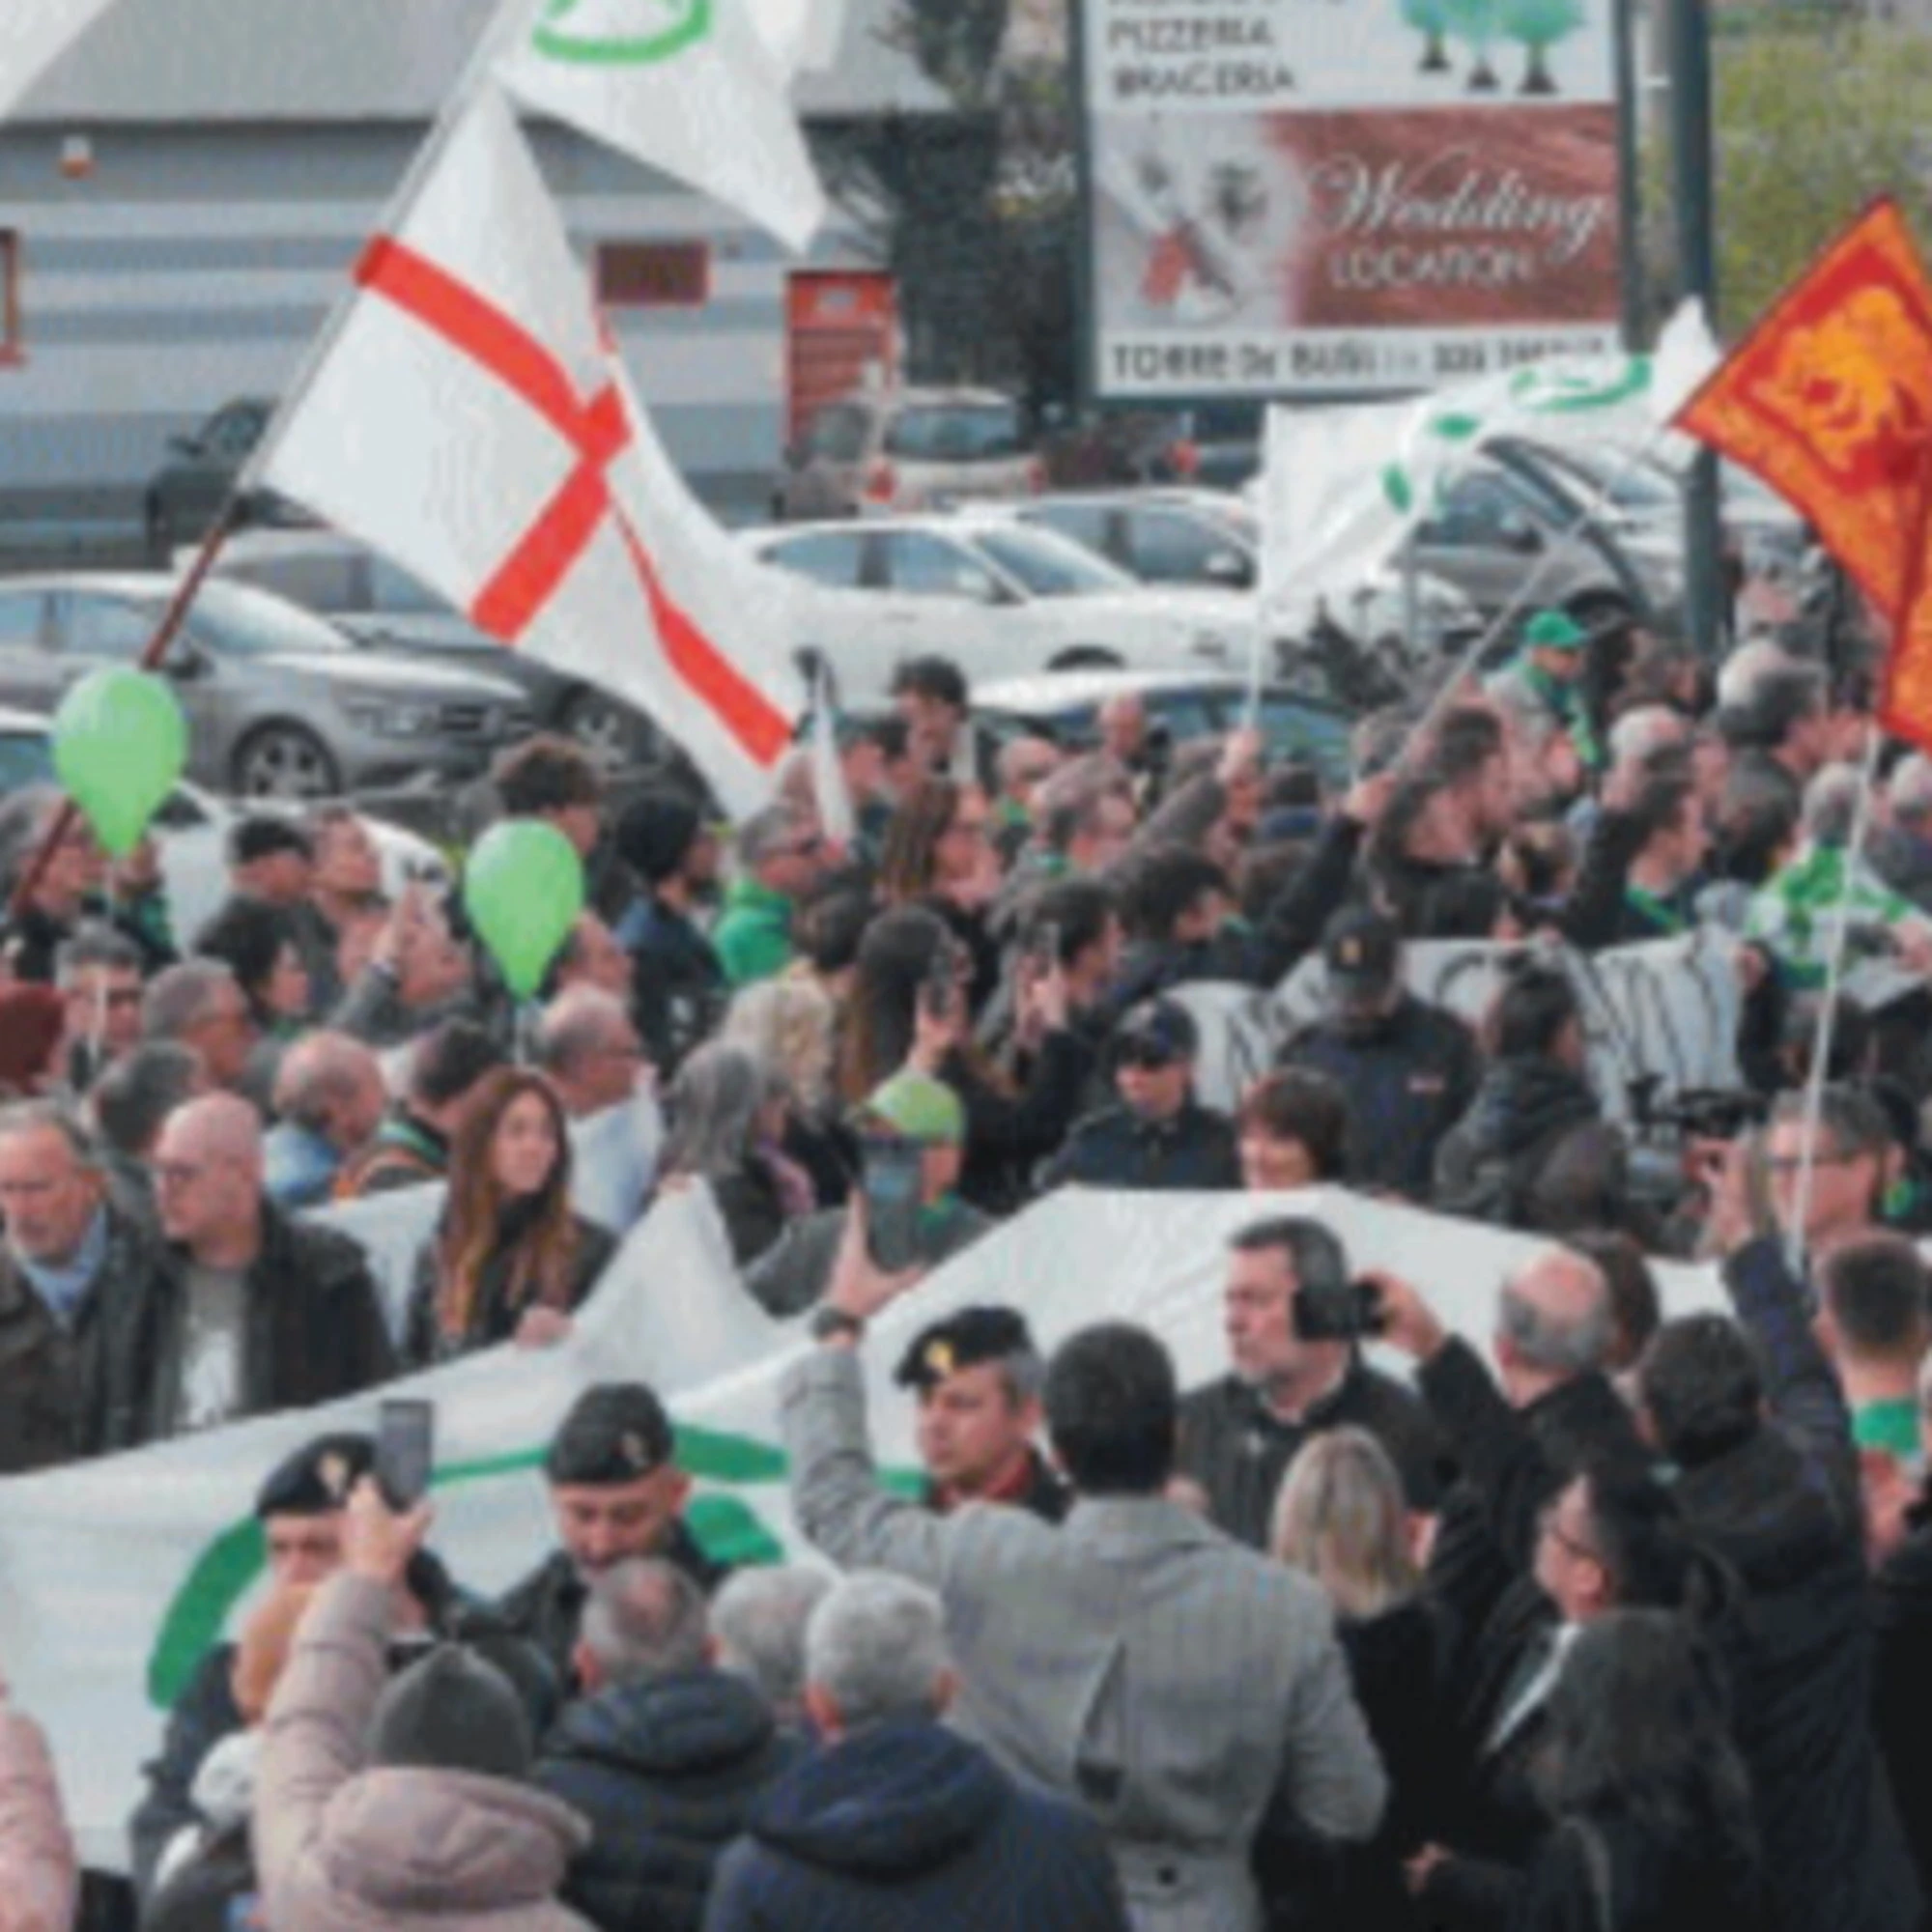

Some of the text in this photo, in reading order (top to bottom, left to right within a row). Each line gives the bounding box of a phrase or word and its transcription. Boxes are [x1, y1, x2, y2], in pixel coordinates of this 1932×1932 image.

[1107, 16, 1274, 54] PIZZERIA
[1114, 57, 1298, 99] BRACERIA
[1306, 143, 1607, 266] Wedding
[1330, 243, 1535, 290] LOCATION
[1113, 343, 1229, 383] TORRE
